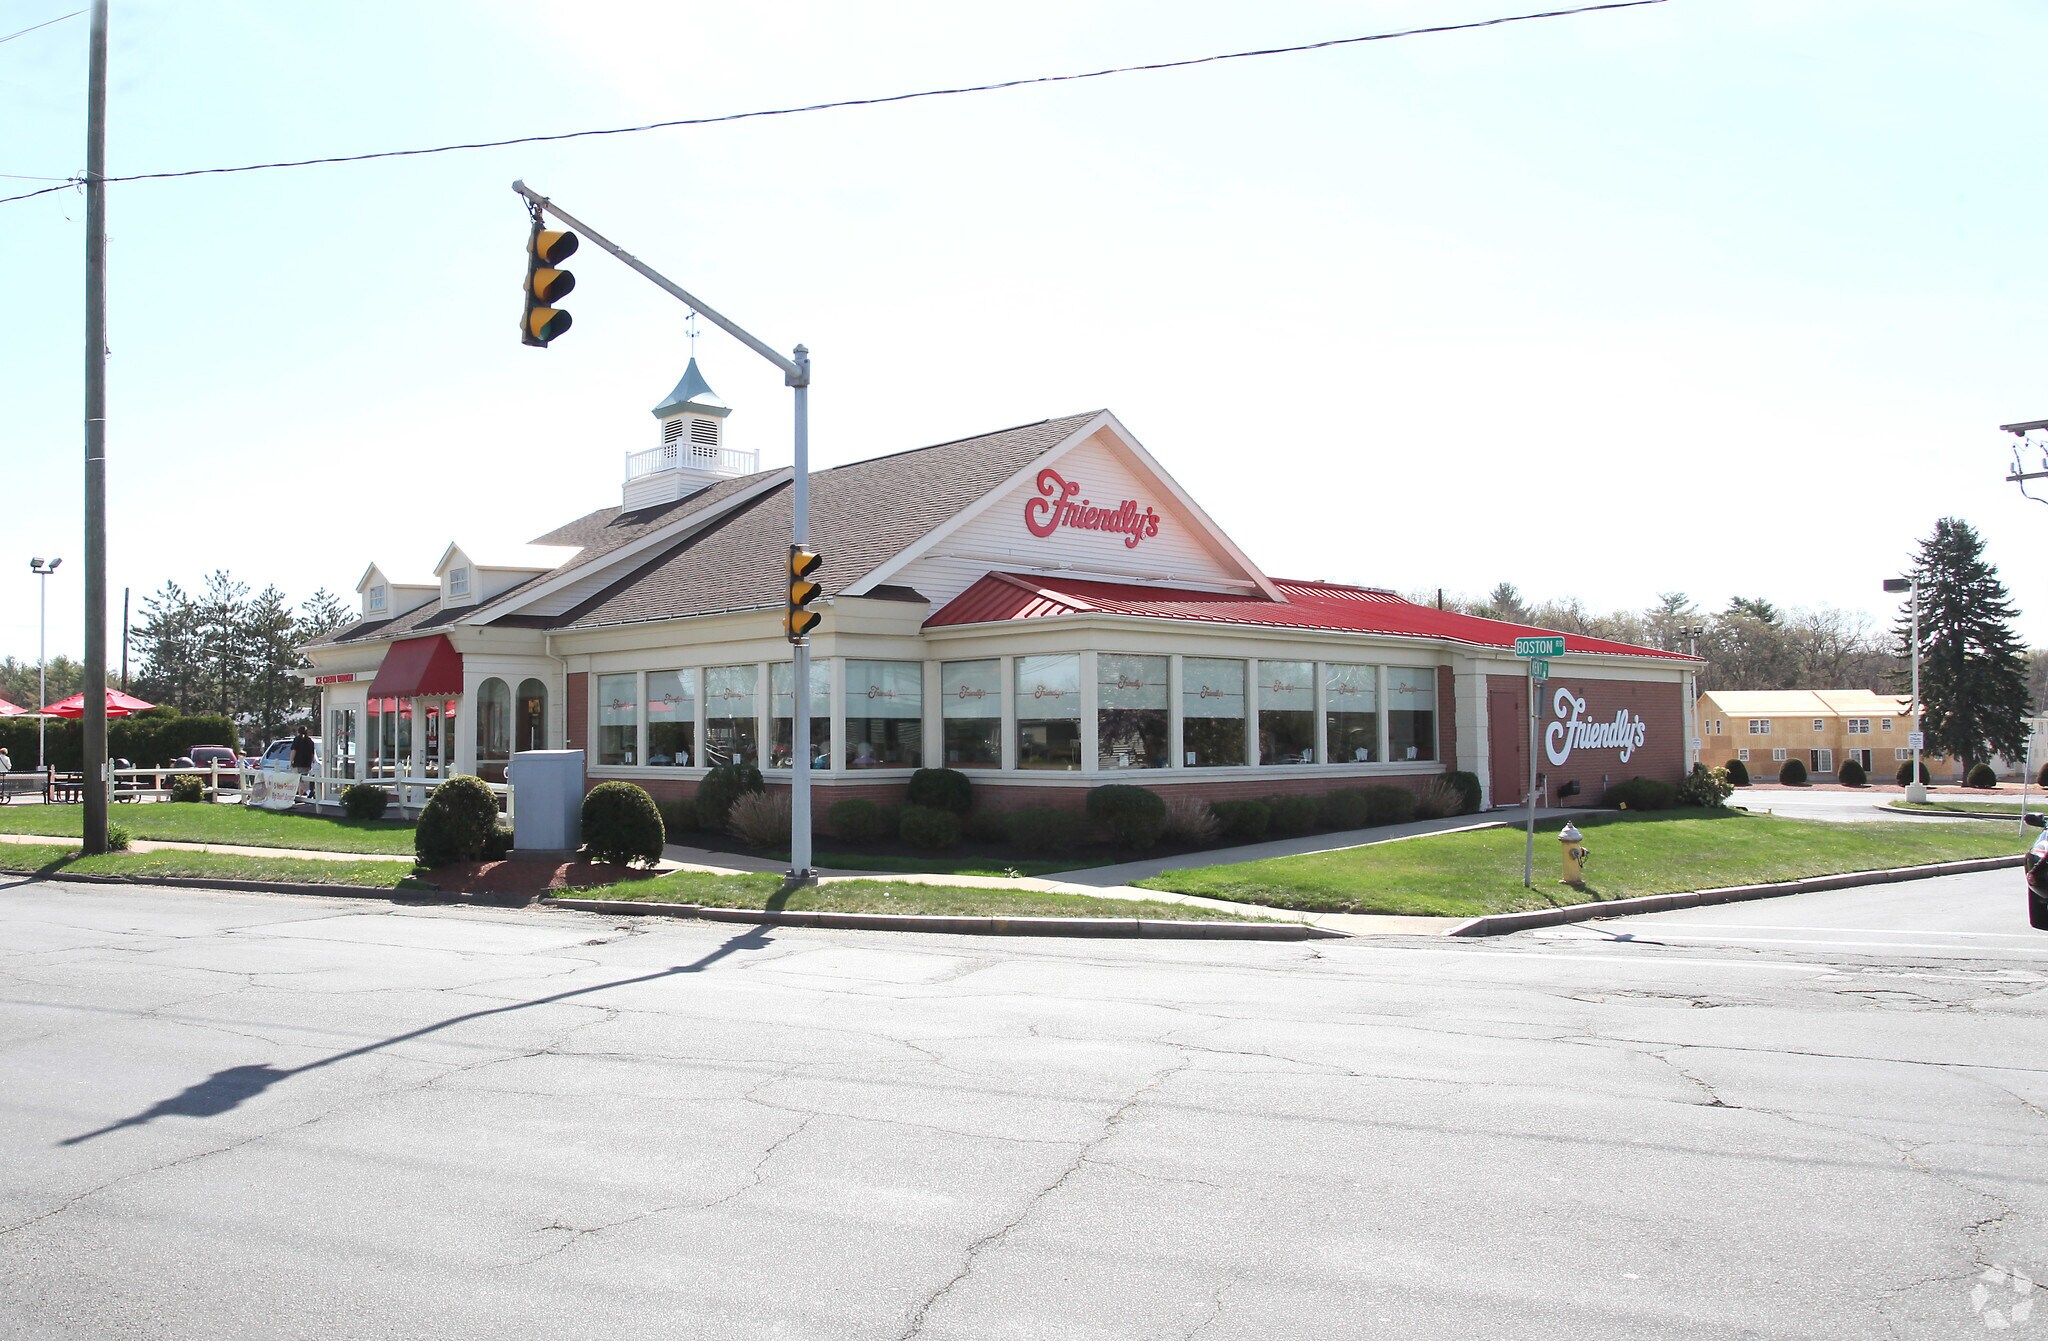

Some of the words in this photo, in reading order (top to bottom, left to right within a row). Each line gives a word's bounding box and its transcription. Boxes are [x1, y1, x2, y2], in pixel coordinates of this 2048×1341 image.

[1025, 469, 1160, 548] Friendly's
[1517, 640, 1553, 654] BOSTON
[1556, 640, 1563, 648] RD
[1545, 688, 1645, 767] Friendly's
